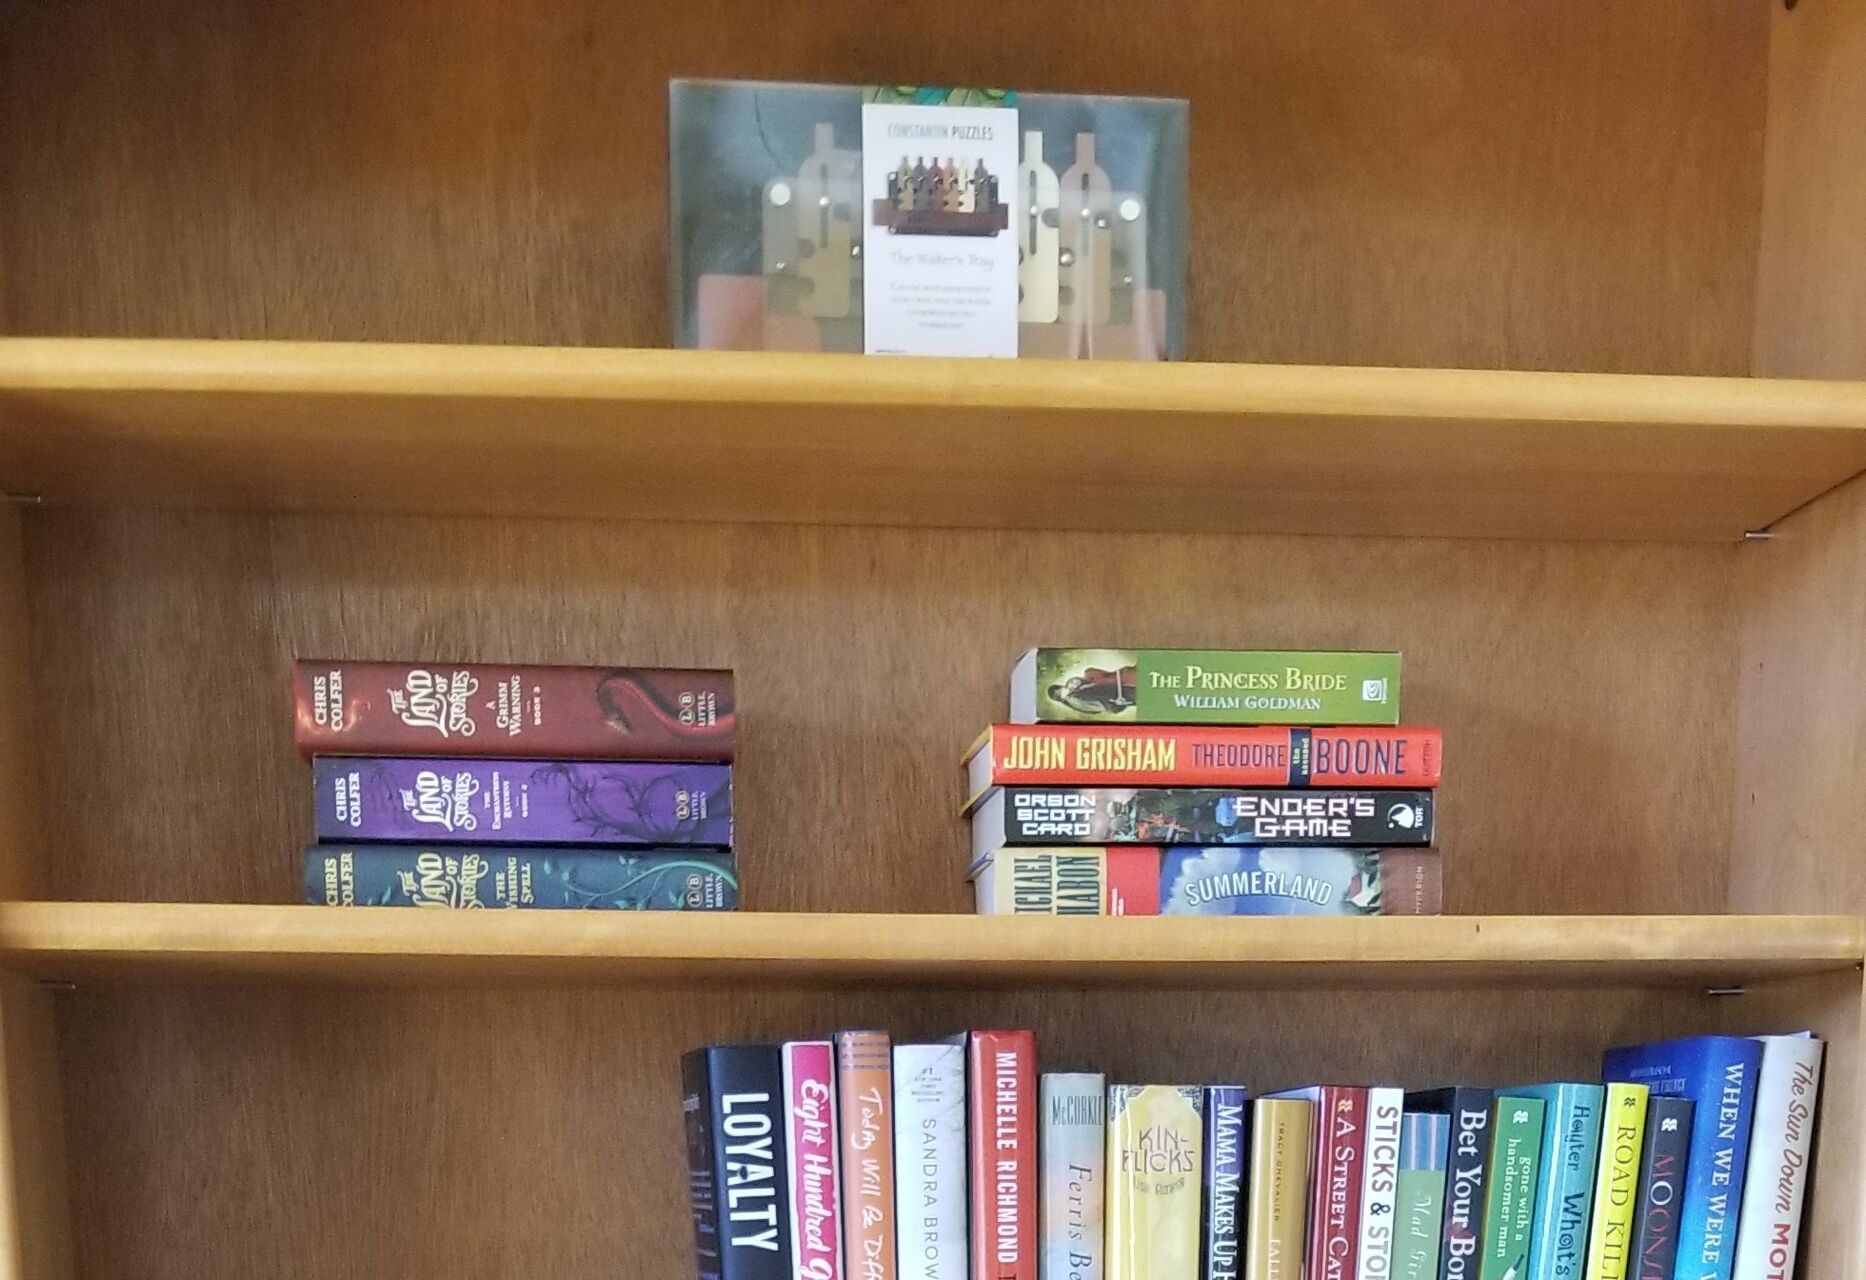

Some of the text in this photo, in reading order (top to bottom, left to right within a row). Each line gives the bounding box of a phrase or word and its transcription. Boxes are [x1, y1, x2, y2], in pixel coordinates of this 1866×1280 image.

[952, 126, 993, 140] PUZZLES
[1150, 666, 1346, 691] THE PRINCESS BRIDE
[314, 676, 326, 725] CHRIS
[330, 669, 342, 731] COLFER
[497, 682, 508, 728] GRIMM
[509, 675, 521, 736] WARNING
[1174, 695, 1321, 710] WILLIAM GOLDMAN
[1004, 737, 1176, 771] JOHN GRISHAM
[1192, 744, 1285, 767] THEODORE
[1316, 739, 1407, 774] BOONE
[335, 777, 347, 820] CHRIS
[349, 772, 361, 827] COLFER
[1015, 794, 1095, 808] ORSON
[1017, 808, 1095, 821] SCOTT
[1232, 797, 1375, 816] ENDER'S
[1022, 822, 1091, 836] CARD
[1254, 818, 1352, 837] GAME
[1415, 807, 1423, 826] TOR
[496, 872, 505, 901] THE
[521, 863, 534, 904] SPELL
[1185, 871, 1332, 905] SUMMERLAND
[996, 1052, 1016, 1150] MICHELLE
[722, 1093, 778, 1251] LOYALTY
[922, 1119, 938, 1209] SANDRA
[996, 1161, 1017, 1263] RICHMOND
[1068, 1163, 1092, 1240] Ferris
[1497, 1137, 1522, 1257] handsomer man
